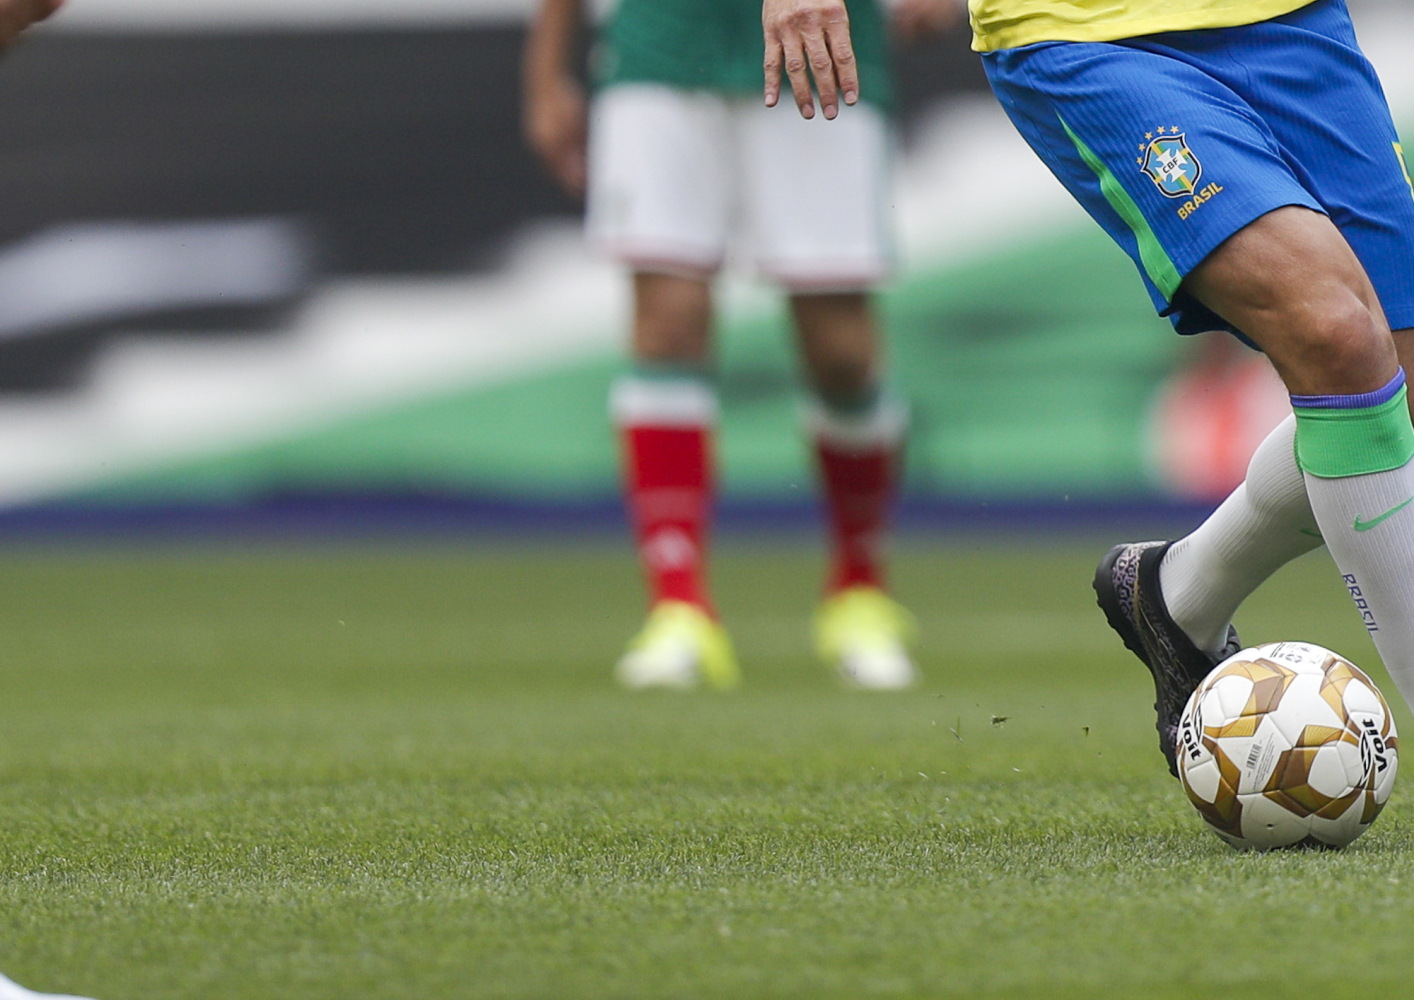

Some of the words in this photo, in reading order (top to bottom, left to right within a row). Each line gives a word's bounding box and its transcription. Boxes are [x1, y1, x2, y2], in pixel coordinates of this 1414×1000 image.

[1162, 156, 1179, 174] CBF
[1176, 181, 1224, 221] BRASIL
[1182, 712, 1202, 762] Voit
[1361, 718, 1388, 773] Voit
